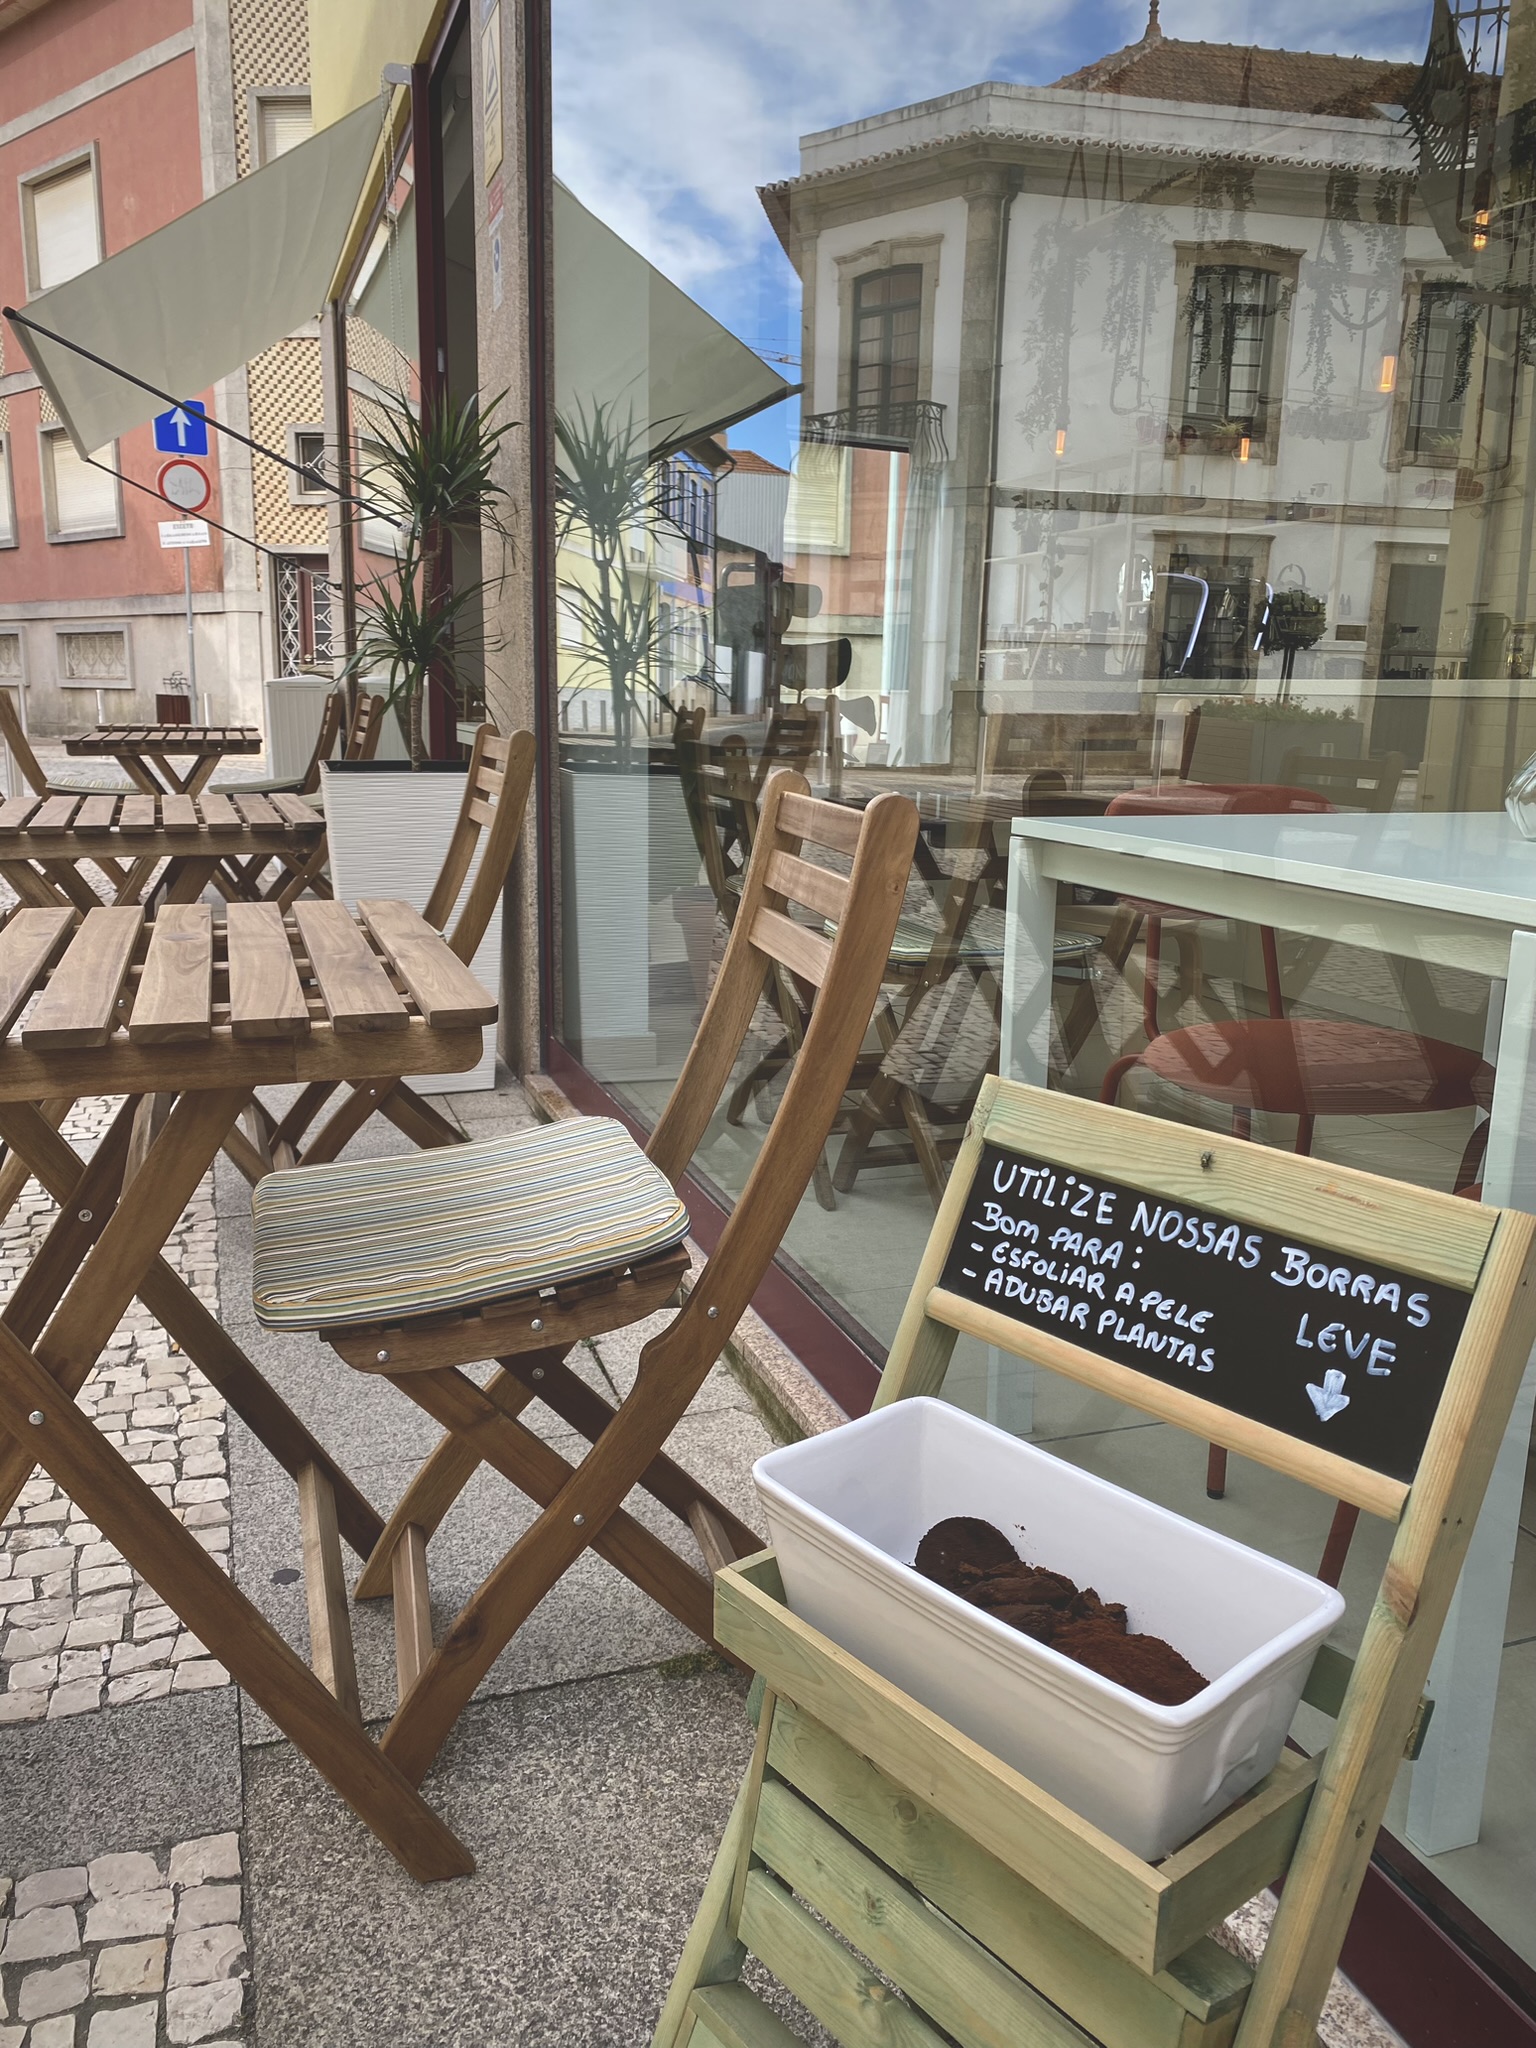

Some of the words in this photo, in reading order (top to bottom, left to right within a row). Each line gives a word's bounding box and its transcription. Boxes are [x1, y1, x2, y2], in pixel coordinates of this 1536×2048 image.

[1130, 1200, 1263, 1269] NOSSAS
[1271, 1246, 1430, 1328] BORRAS
[983, 1267, 1091, 1330] ADUBAR
[1097, 1309, 1215, 1373] PLANTAS
[1139, 1290, 1214, 1334] PELE
[1295, 1312, 1397, 1376] LEVE
